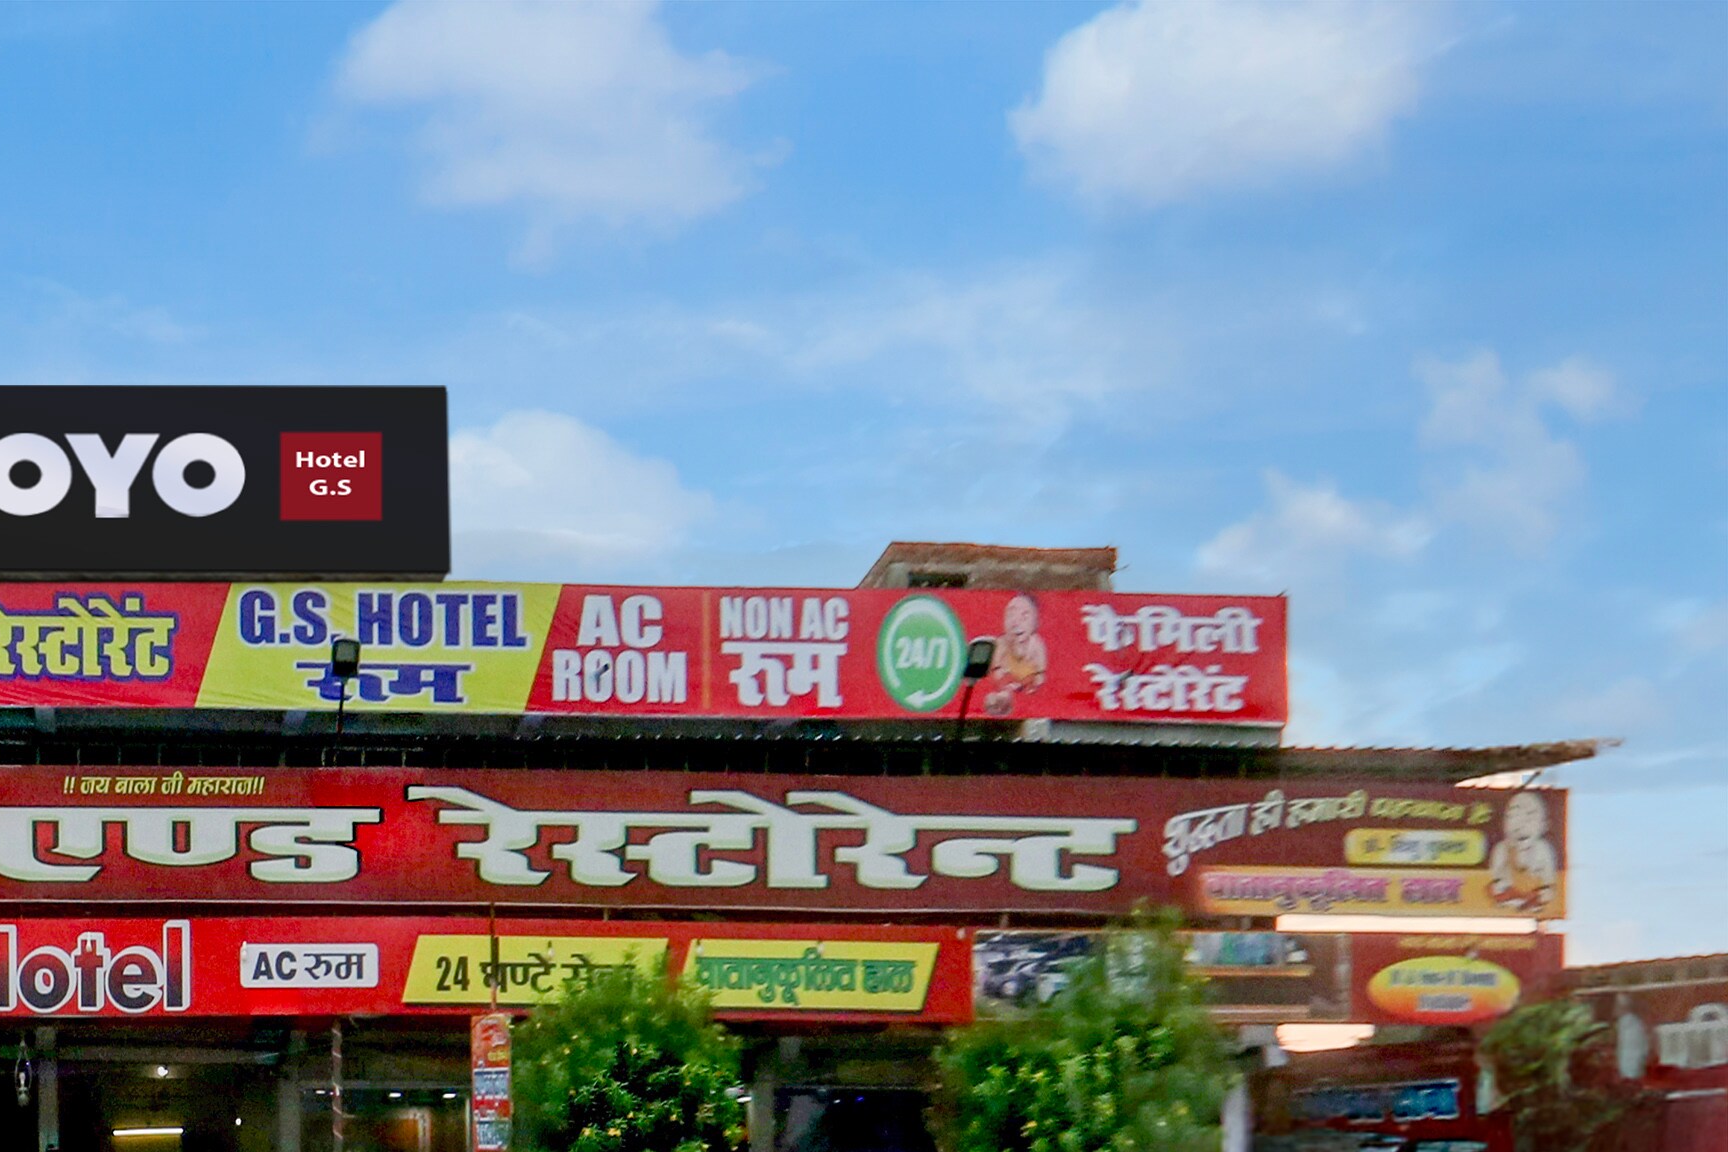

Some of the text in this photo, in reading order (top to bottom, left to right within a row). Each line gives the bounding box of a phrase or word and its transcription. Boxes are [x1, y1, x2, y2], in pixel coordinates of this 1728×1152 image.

[296, 450, 365, 468] Hotel
[309, 479, 352, 496] G.S
[358, 593, 526, 647] HOTEL
[577, 595, 663, 647] AC
[719, 596, 849, 641] NON AC
[895, 634, 949, 670] 24/7
[551, 649, 686, 703] ROOM
[80, 776, 111, 794] जय
[161, 770, 184, 794] जी
[406, 784, 1138, 892] रेस्टोरेन्ट
[252, 951, 297, 981] AC
[436, 956, 470, 991] 24
